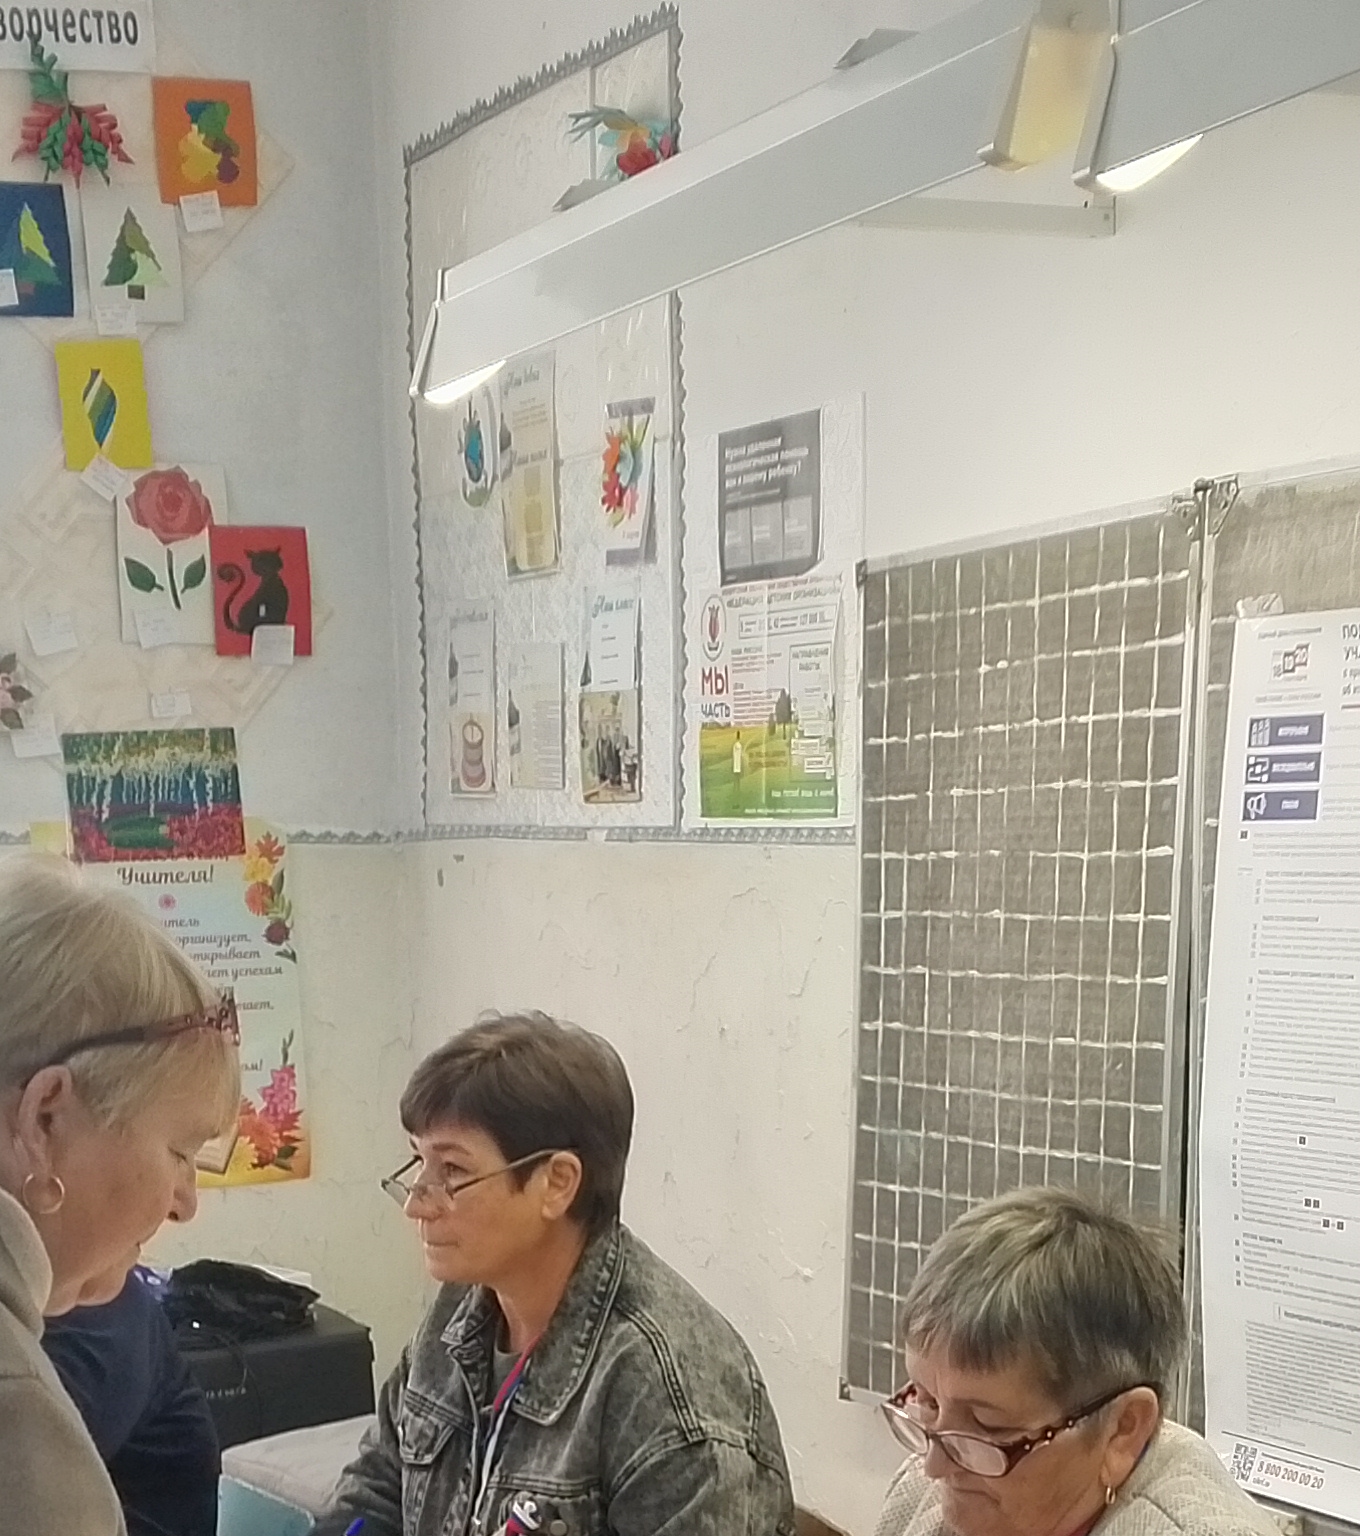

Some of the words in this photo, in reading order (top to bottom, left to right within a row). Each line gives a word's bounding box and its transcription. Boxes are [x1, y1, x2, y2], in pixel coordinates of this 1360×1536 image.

[701, 664, 729, 696] МЫ
[701, 702, 731, 718] ЧАСТЬ
[116, 864, 215, 886] Учителя!
[190, 946, 262, 966] ткрывает
